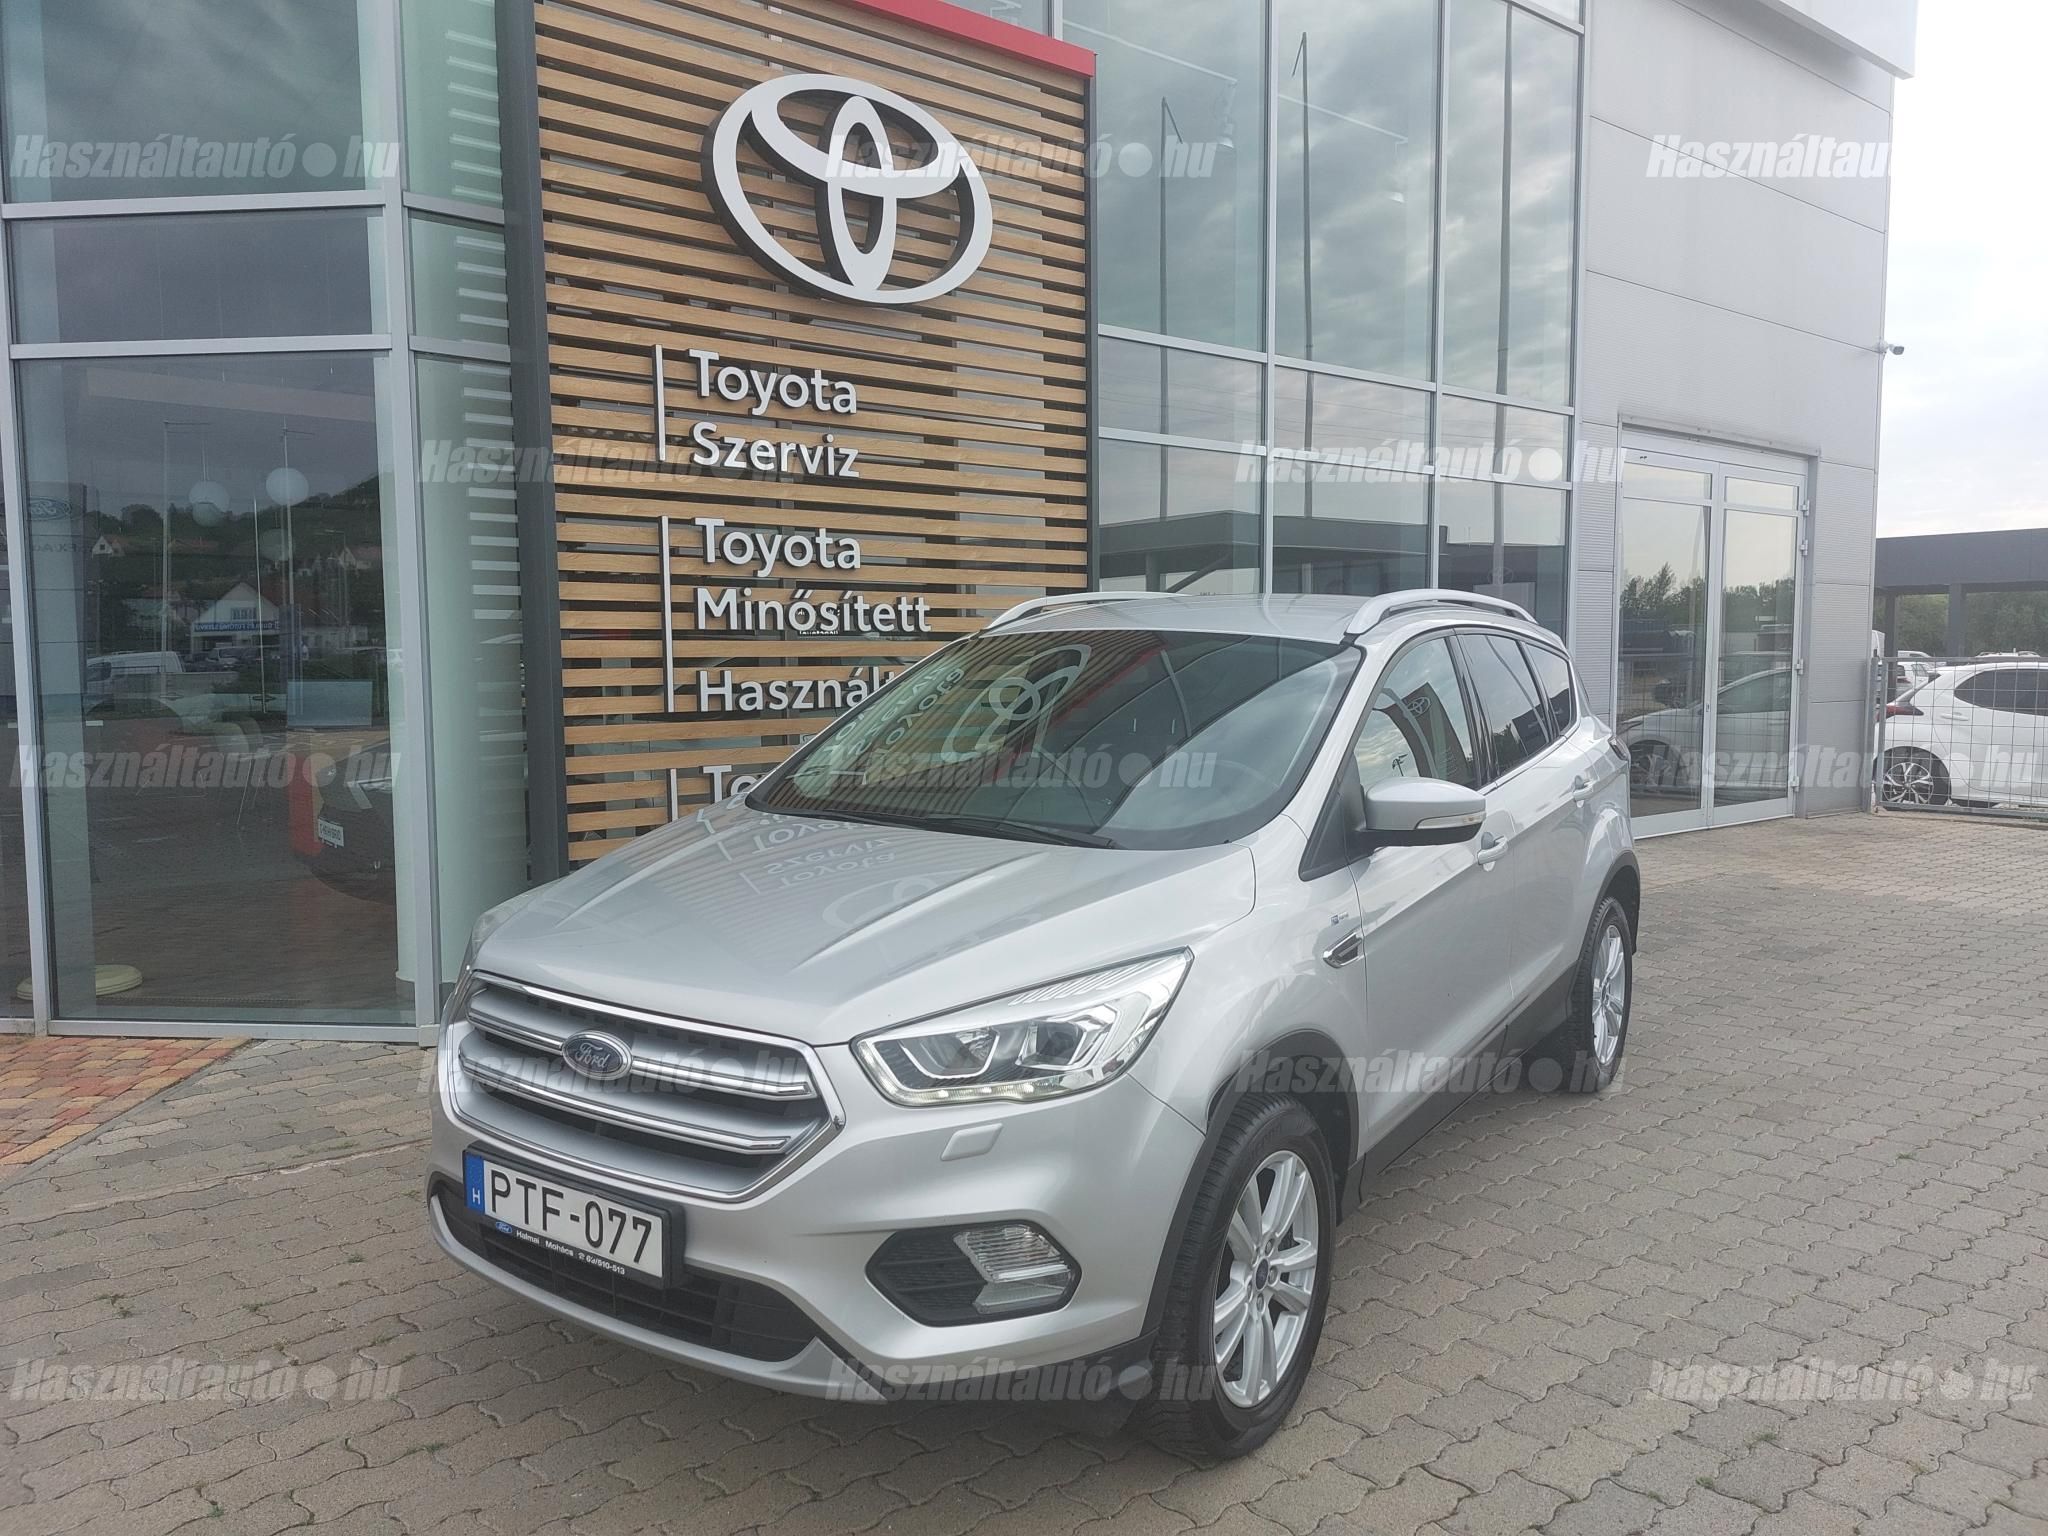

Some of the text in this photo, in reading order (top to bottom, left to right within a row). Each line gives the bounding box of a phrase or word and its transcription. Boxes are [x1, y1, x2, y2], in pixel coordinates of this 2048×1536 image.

[689, 347, 858, 417] Toyota
[690, 421, 860, 478] Szerviz
[694, 517, 861, 577] Toyota
[694, 587, 932, 632] Minősített
[697, 666, 896, 712] Használ
[472, 1169, 652, 1264] H PTF-077
